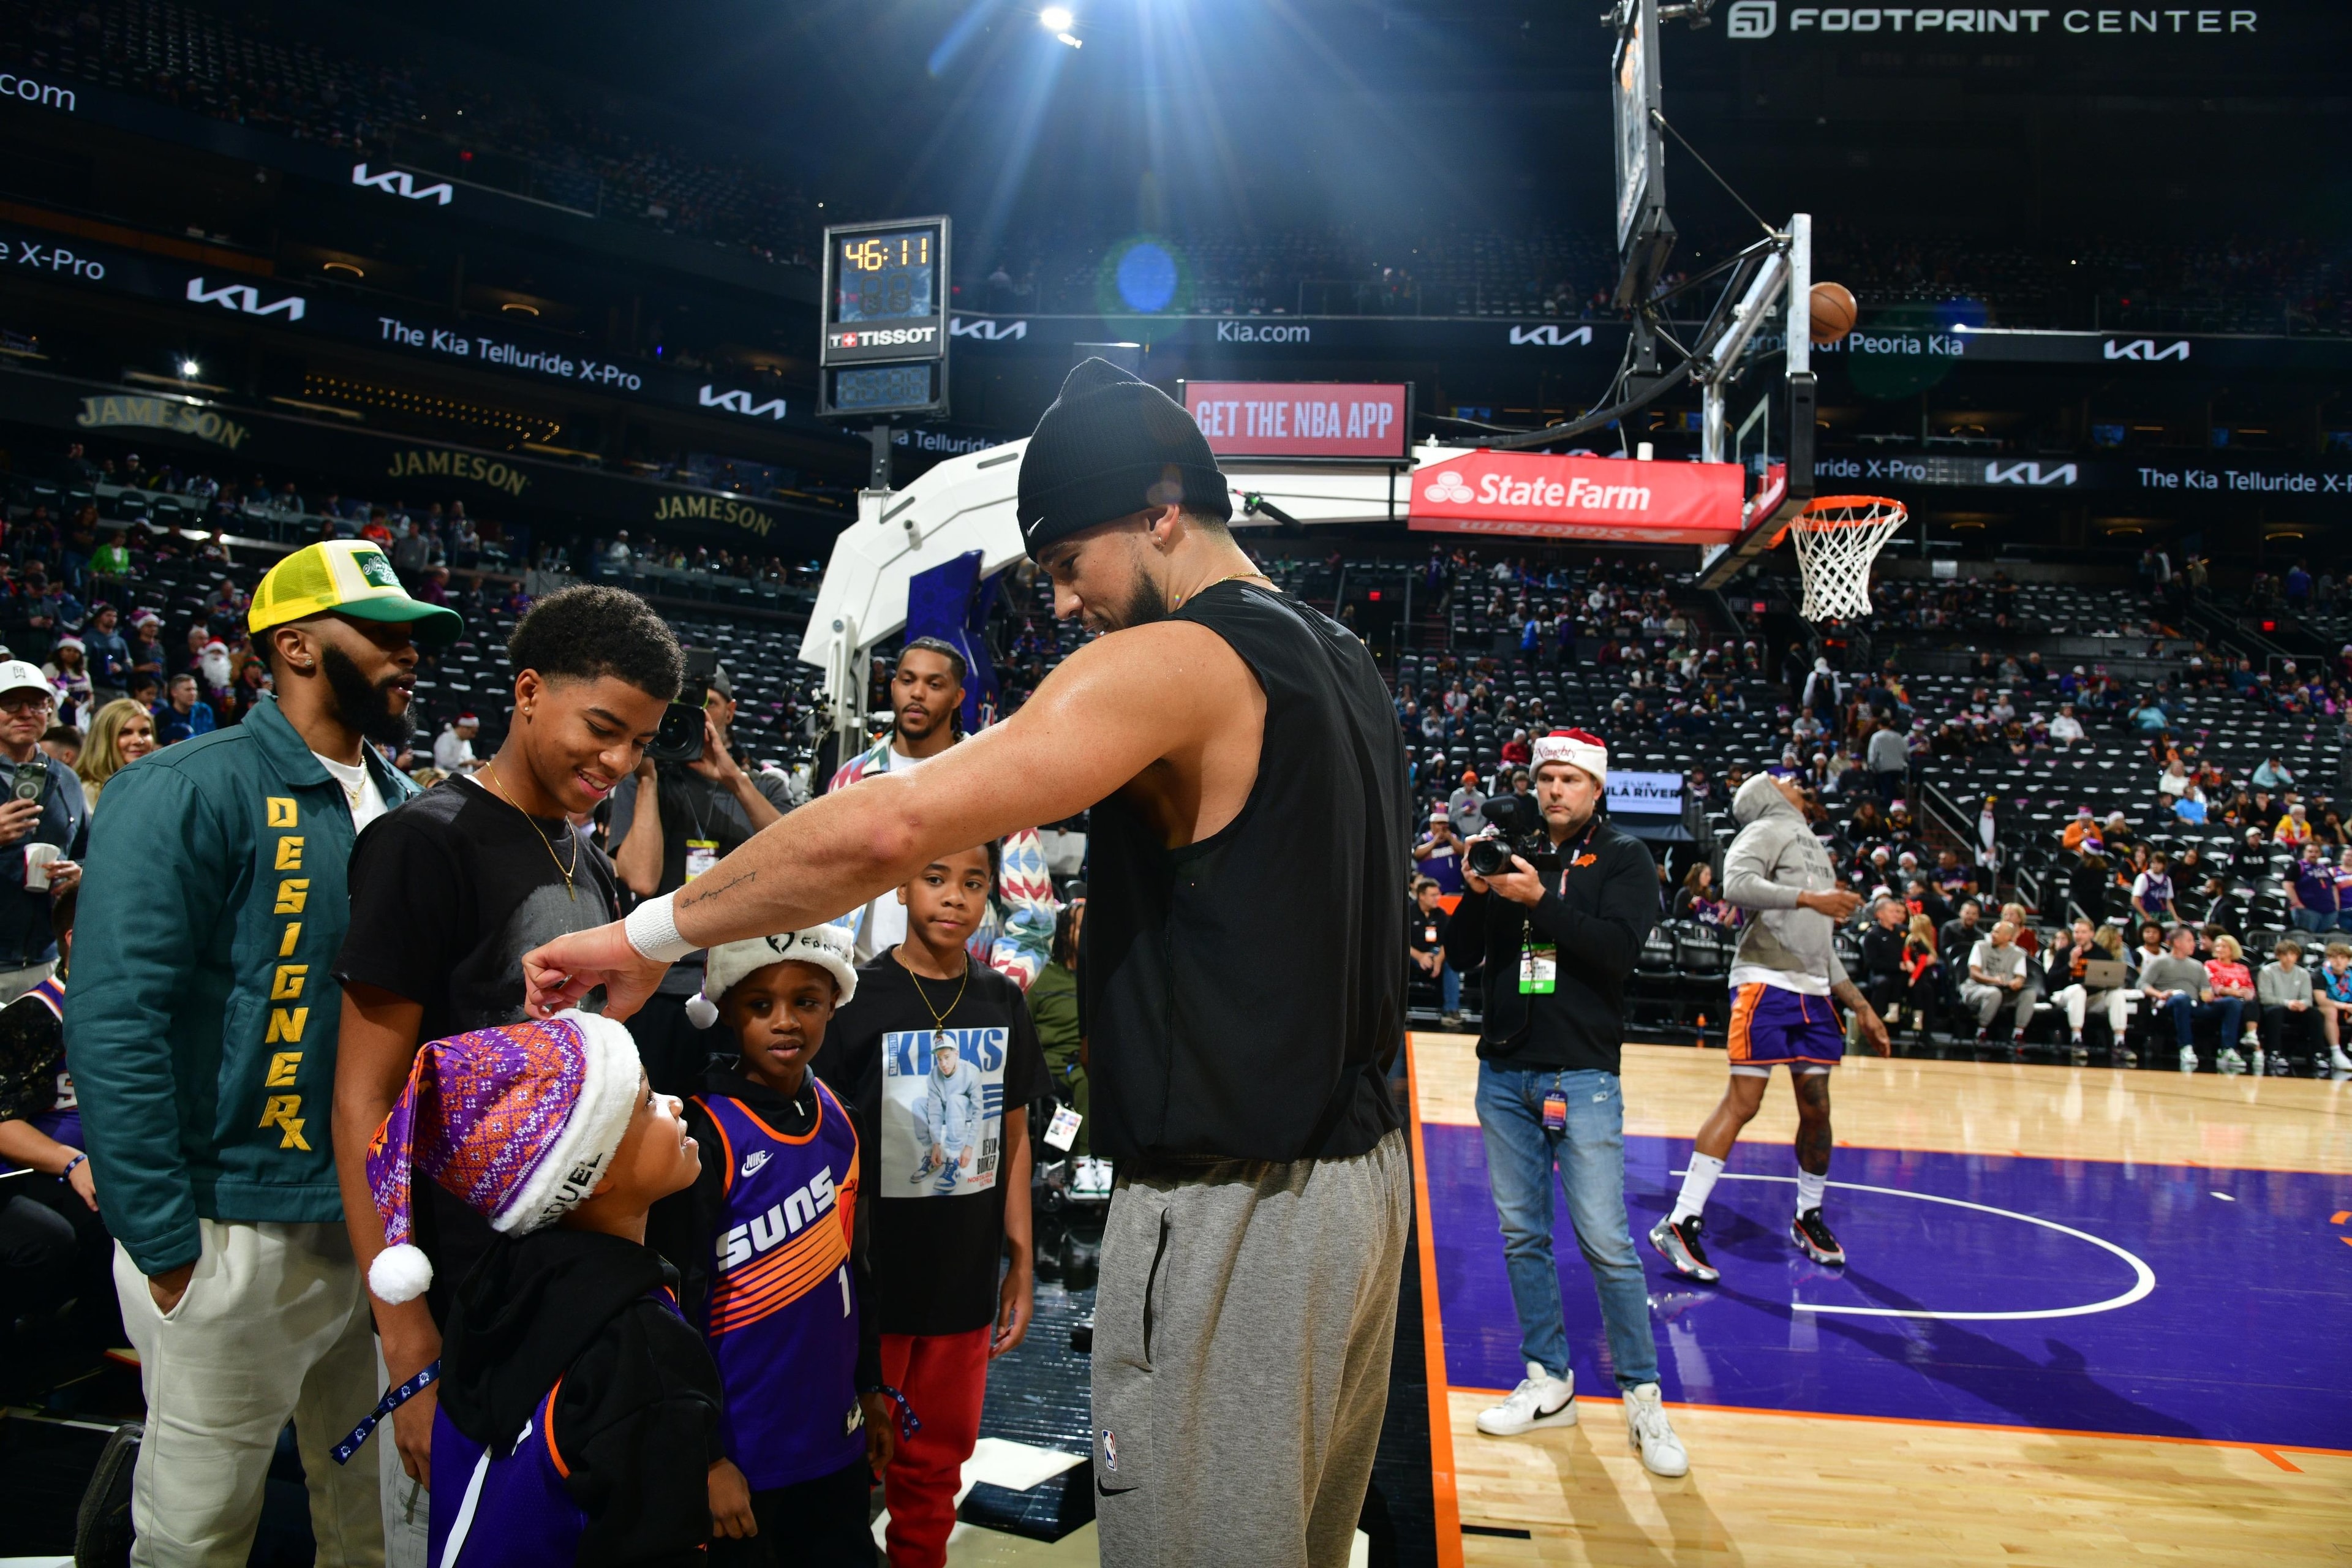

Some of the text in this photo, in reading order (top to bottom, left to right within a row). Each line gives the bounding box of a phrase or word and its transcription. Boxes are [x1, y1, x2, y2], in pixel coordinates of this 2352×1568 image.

[1790, 9, 2257, 33] FOOTPRINT CENTER
[18, 241, 105, 280] X-Pro
[845, 238, 927, 270] 46:11
[858, 326, 937, 348] TISSOT
[1216, 322, 1310, 342] Kia.com
[1850, 332, 1921, 354] Peoria
[1929, 333, 1964, 355] Kia
[379, 317, 642, 391] The Kia Telluride X-Pro
[77, 395, 246, 450] JAMESON
[1197, 401, 1393, 439] GET THE NBA APP
[388, 450, 527, 497] JAMESON
[1866, 459, 1927, 481] X-Pro
[2138, 467, 2179, 488] The
[2185, 469, 2218, 489] Kia
[2224, 470, 2317, 492] Telluride
[654, 495, 772, 537] JAMESON
[746, 1150, 766, 1168] NIKE
[838, 1264, 850, 1318] 1
